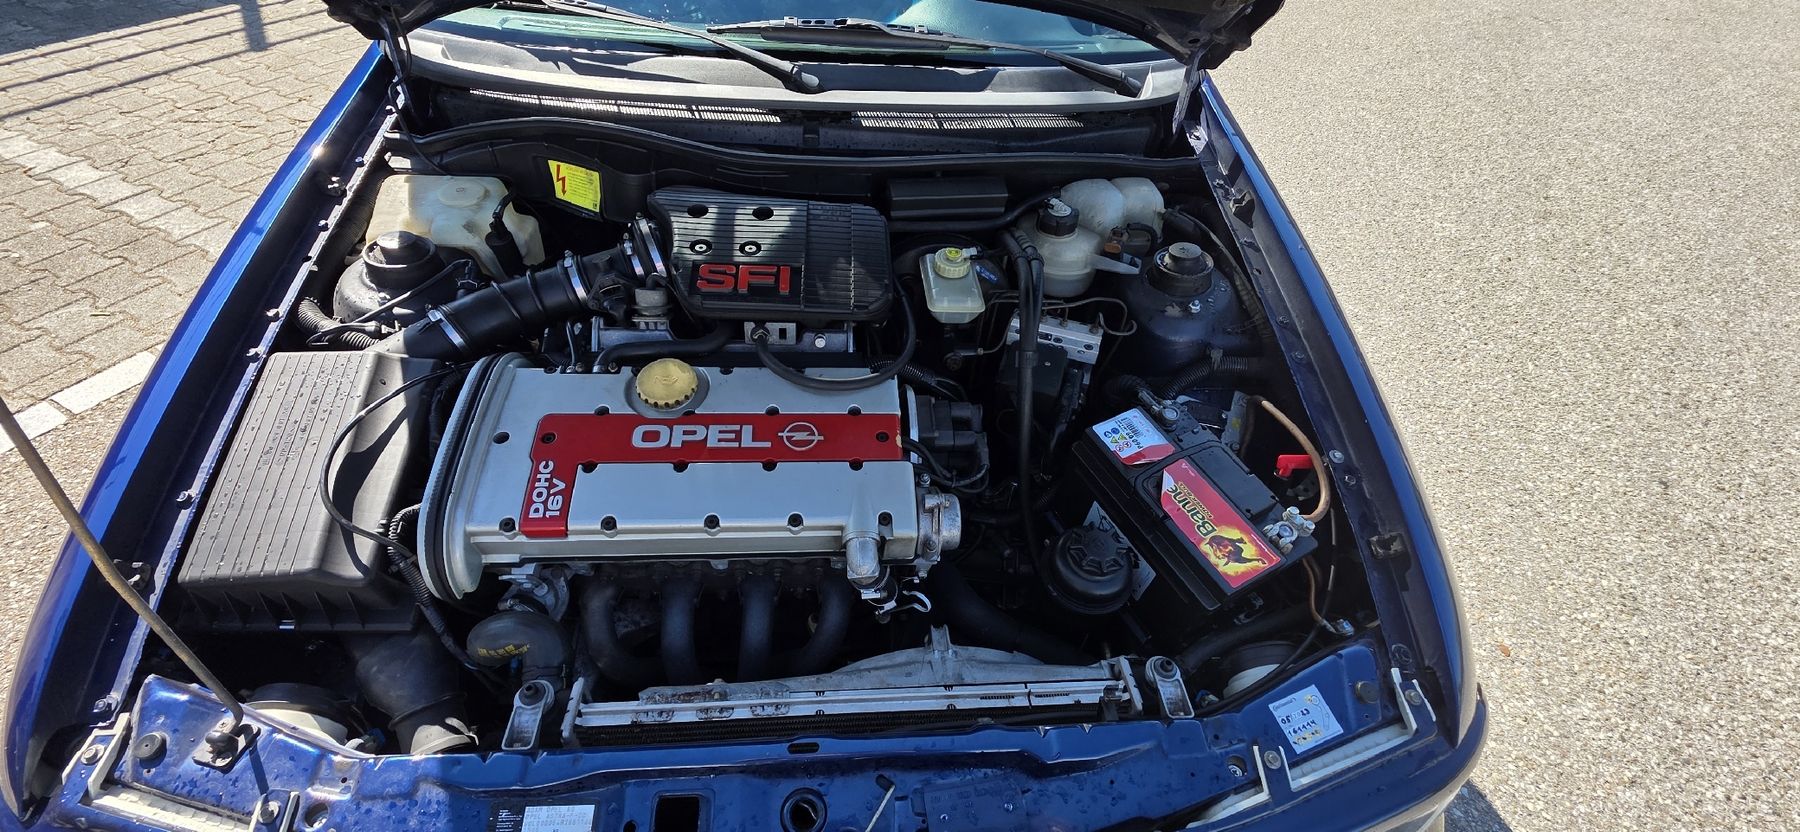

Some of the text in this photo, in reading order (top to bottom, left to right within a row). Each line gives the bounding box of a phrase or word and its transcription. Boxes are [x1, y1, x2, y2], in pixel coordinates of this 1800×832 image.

[696, 263, 791, 294] SFI
[631, 424, 772, 448] OPEL
[528, 460, 554, 519] DOHC
[545, 477, 566, 518] 16V
[1166, 484, 1217, 537] Banne
